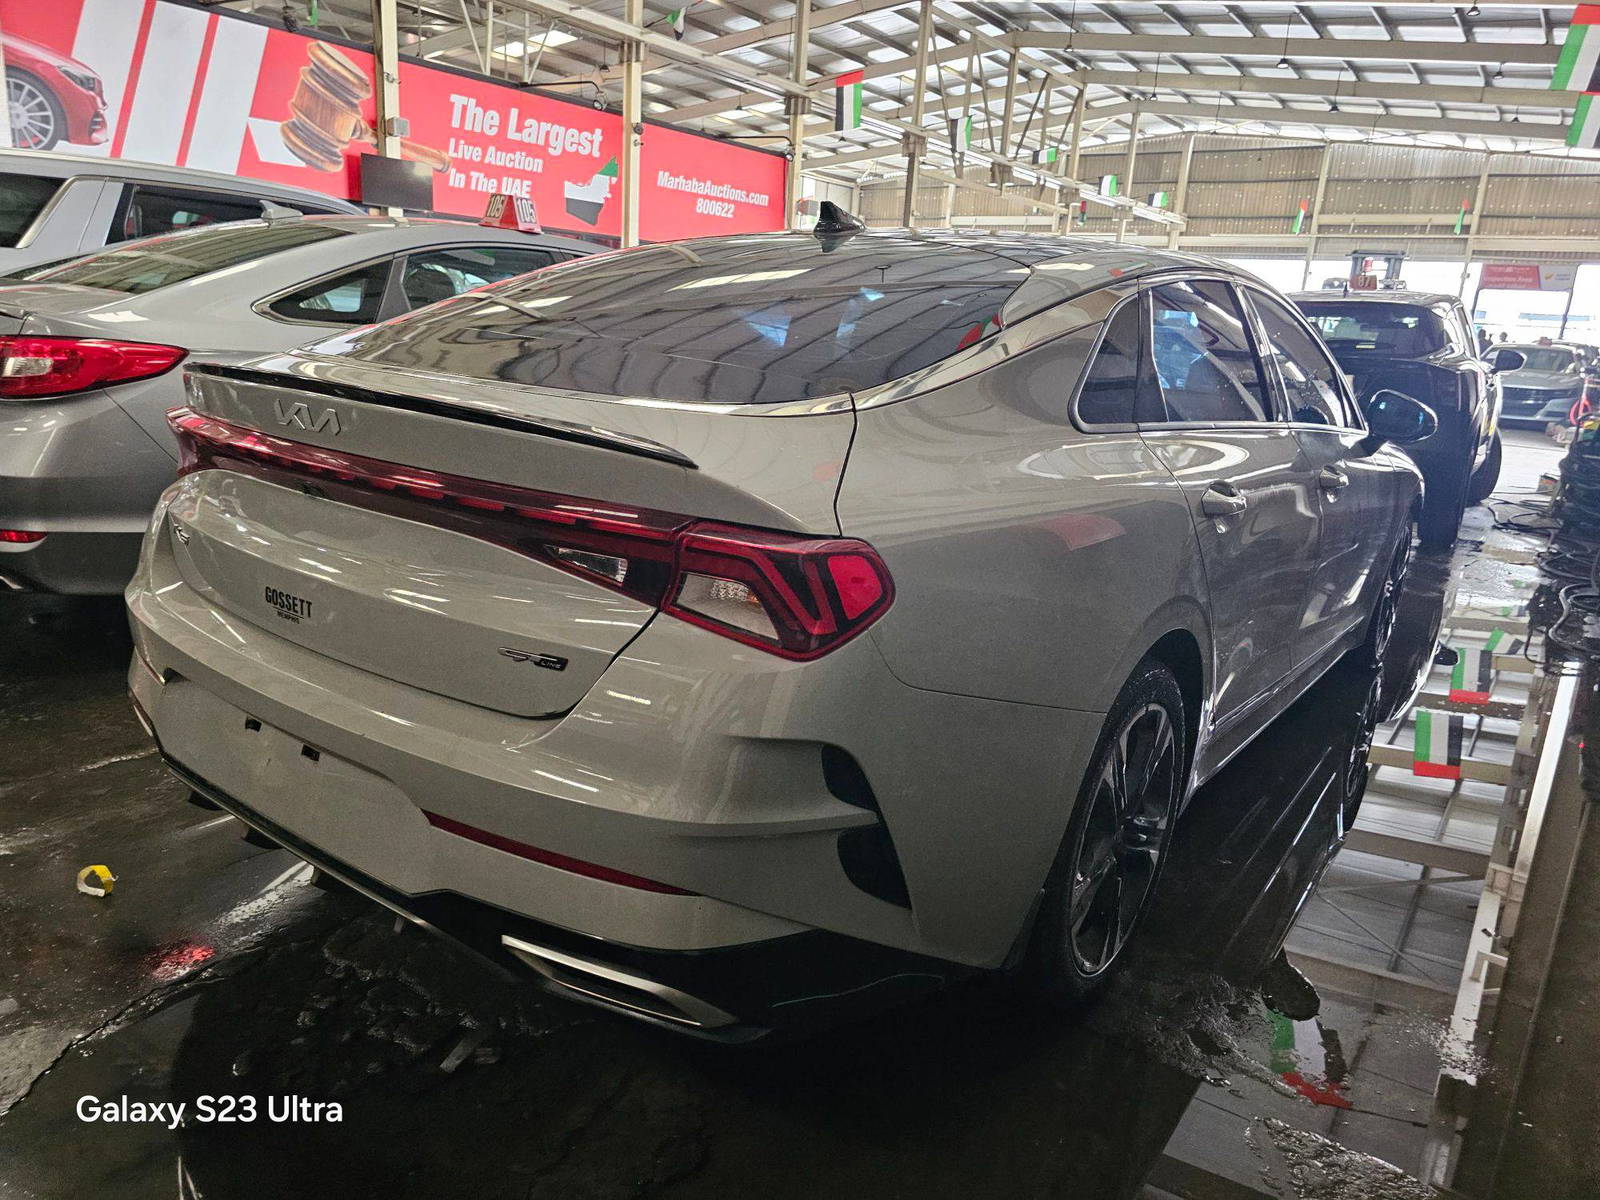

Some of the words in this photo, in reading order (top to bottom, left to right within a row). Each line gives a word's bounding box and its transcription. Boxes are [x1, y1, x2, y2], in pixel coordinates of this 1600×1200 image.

[450, 94, 500, 136] The
[507, 108, 603, 158] Largest
[449, 138, 482, 162] Live
[484, 146, 543, 173] Auction
[449, 168, 465, 188] In
[470, 171, 497, 194] The
[501, 177, 532, 198] UAE
[657, 170, 769, 207] MarhabaAuctions.com
[516, 198, 537, 223] 105
[696, 198, 735, 218] 800622
[274, 398, 341, 436] KIA
[265, 586, 312, 618] GOSSETT
